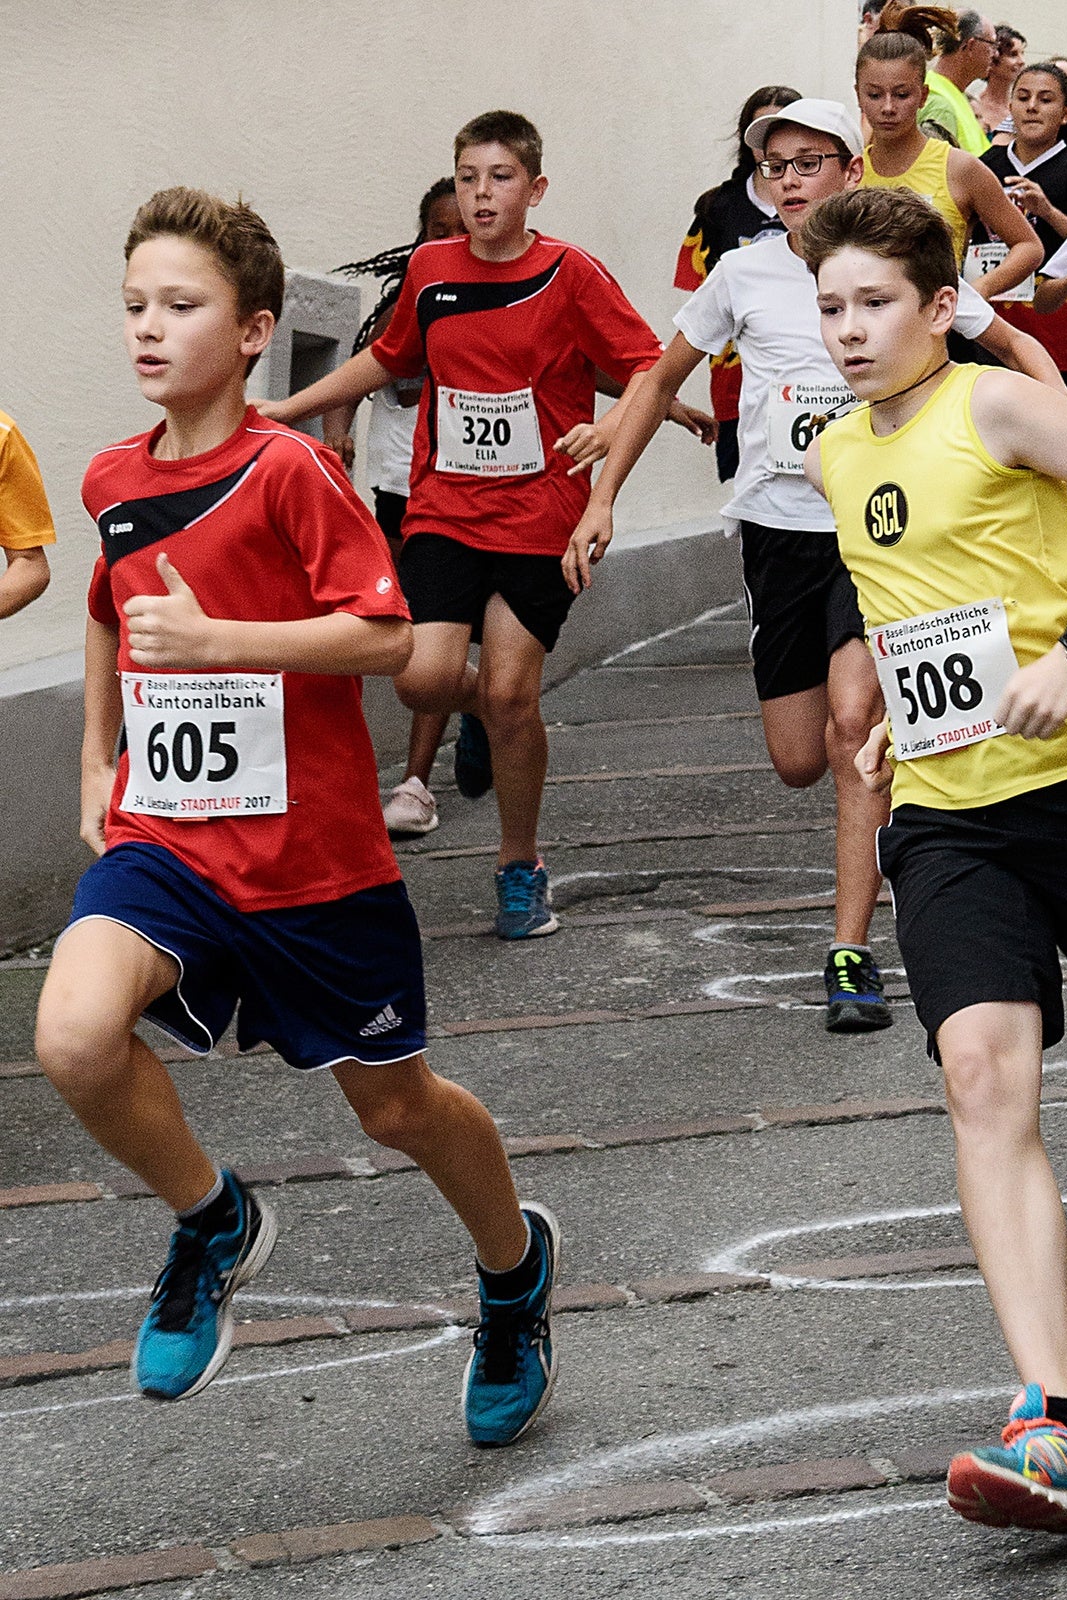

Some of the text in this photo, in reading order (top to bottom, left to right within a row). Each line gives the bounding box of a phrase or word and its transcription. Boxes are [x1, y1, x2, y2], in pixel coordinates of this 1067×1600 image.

[459, 401, 530, 414] Kantonalbank
[462, 415, 511, 447] 320
[475, 449, 498, 461] ELIA
[521, 461, 538, 471] 2017
[871, 490, 903, 539] SCL
[885, 606, 989, 639] Basellandschaftliche
[889, 619, 992, 657] Kantonalbank
[147, 679, 267, 690] Basellandschaftliche
[895, 653, 983, 725] 508
[147, 693, 266, 709] Kantonalbank
[936, 720, 992, 746] STADTLAUF
[147, 721, 239, 783] 605
[181, 798, 241, 811] STADTLAUF
[245, 796, 271, 809] 2017
